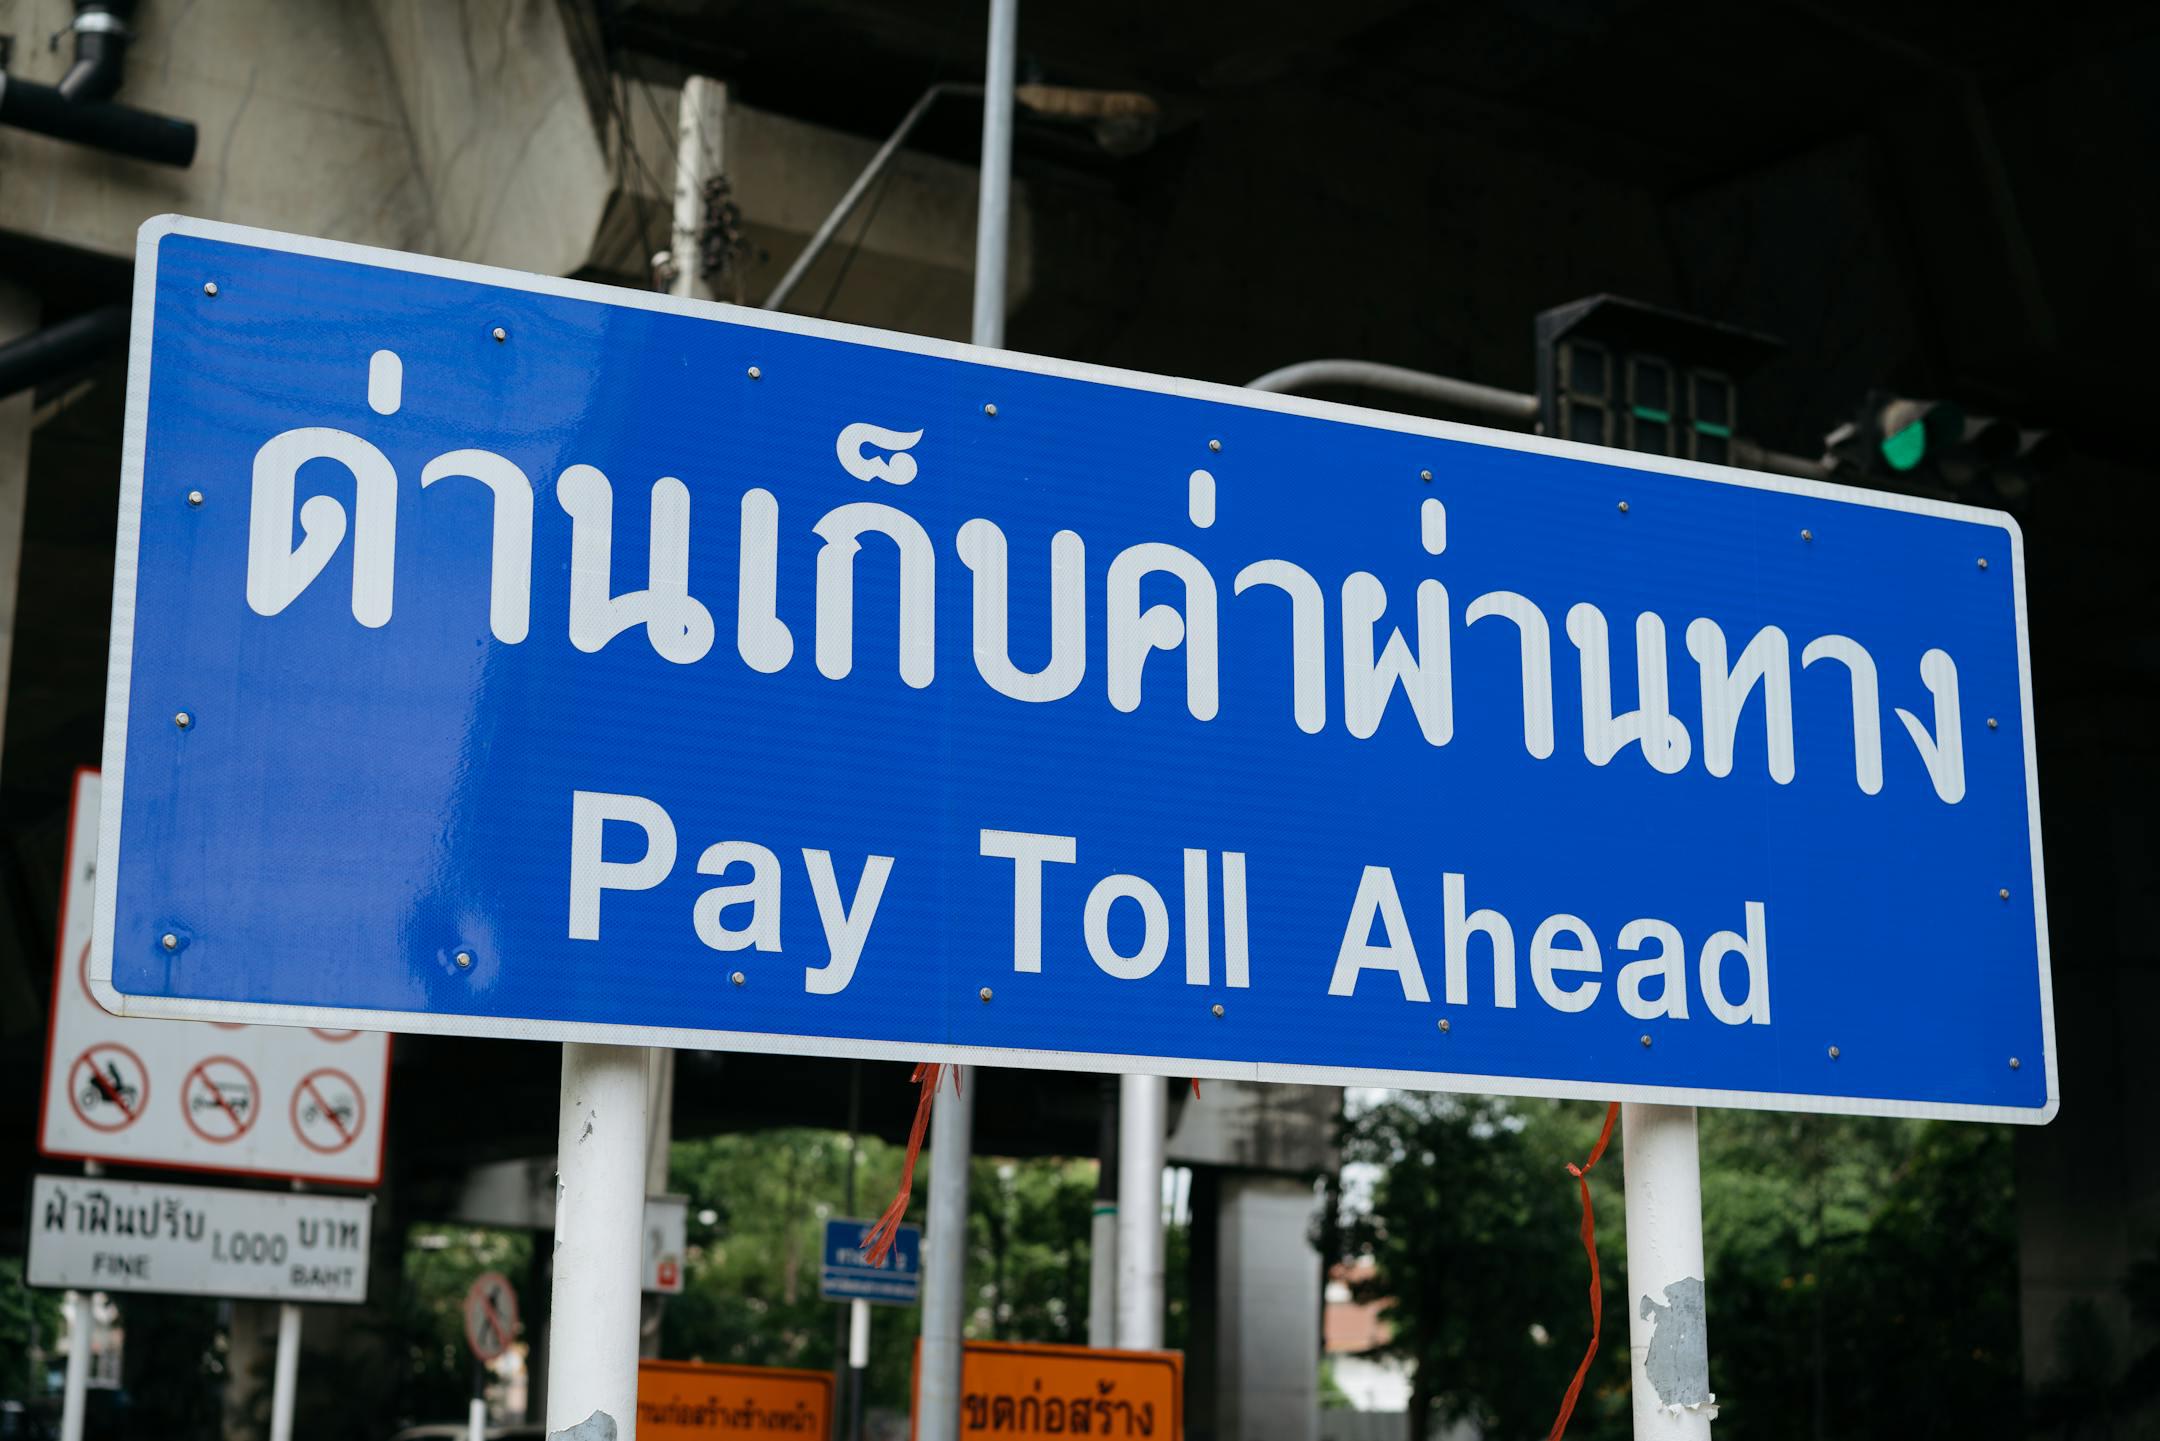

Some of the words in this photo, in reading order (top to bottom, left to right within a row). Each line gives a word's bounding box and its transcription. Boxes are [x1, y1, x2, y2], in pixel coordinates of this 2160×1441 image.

[245, 348, 1967, 806] ด่านเก็บค่าผ่านทาง
[567, 789, 896, 995] Pay
[978, 828, 1250, 989] Toll
[1327, 865, 1771, 1027] Ahead
[44, 1186, 205, 1242] ฝ่าฝืนปรับ
[297, 1216, 360, 1251] บาท
[92, 1252, 150, 1280] FINE
[289, 1263, 356, 1289] BAHT
